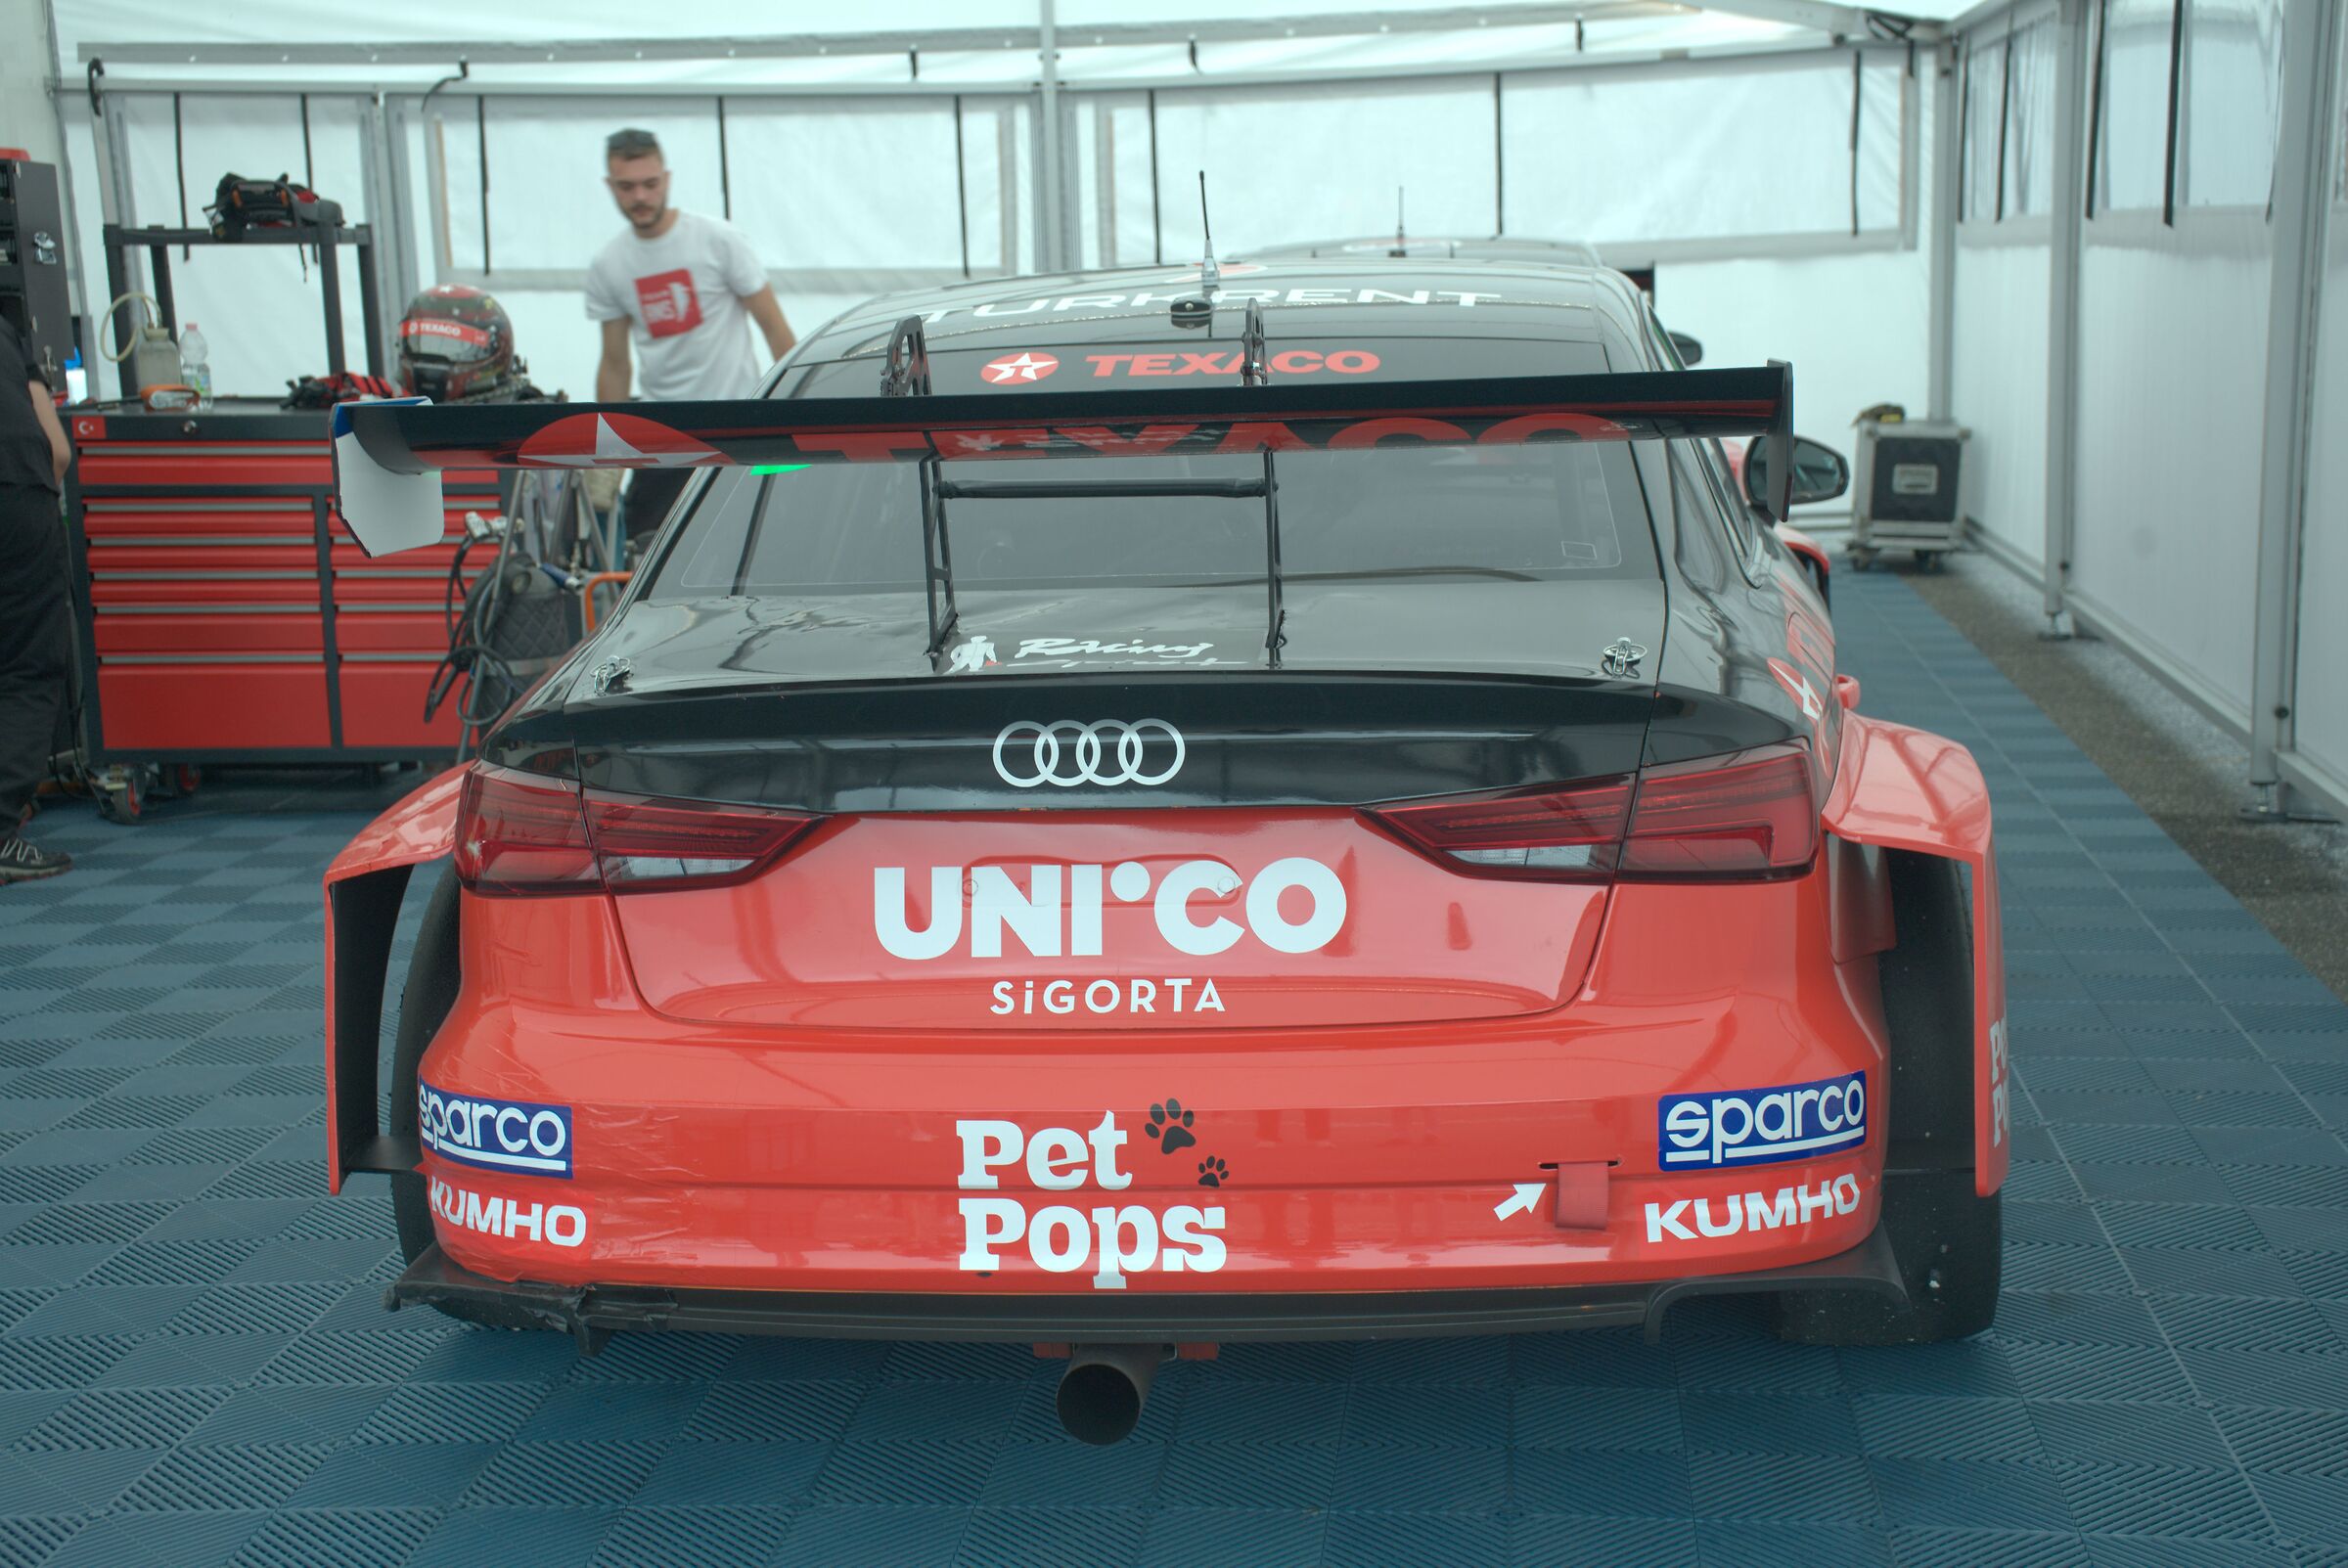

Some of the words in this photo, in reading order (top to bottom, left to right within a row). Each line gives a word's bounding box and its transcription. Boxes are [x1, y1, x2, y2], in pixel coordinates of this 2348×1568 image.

[419, 1084, 566, 1157] sparco
[955, 1109, 1133, 1191] Pet
[1665, 1079, 1865, 1164] sparco
[429, 1176, 587, 1248] KUMHO
[958, 1197, 1228, 1290] Pops
[1644, 1173, 1861, 1244] KUMHO
